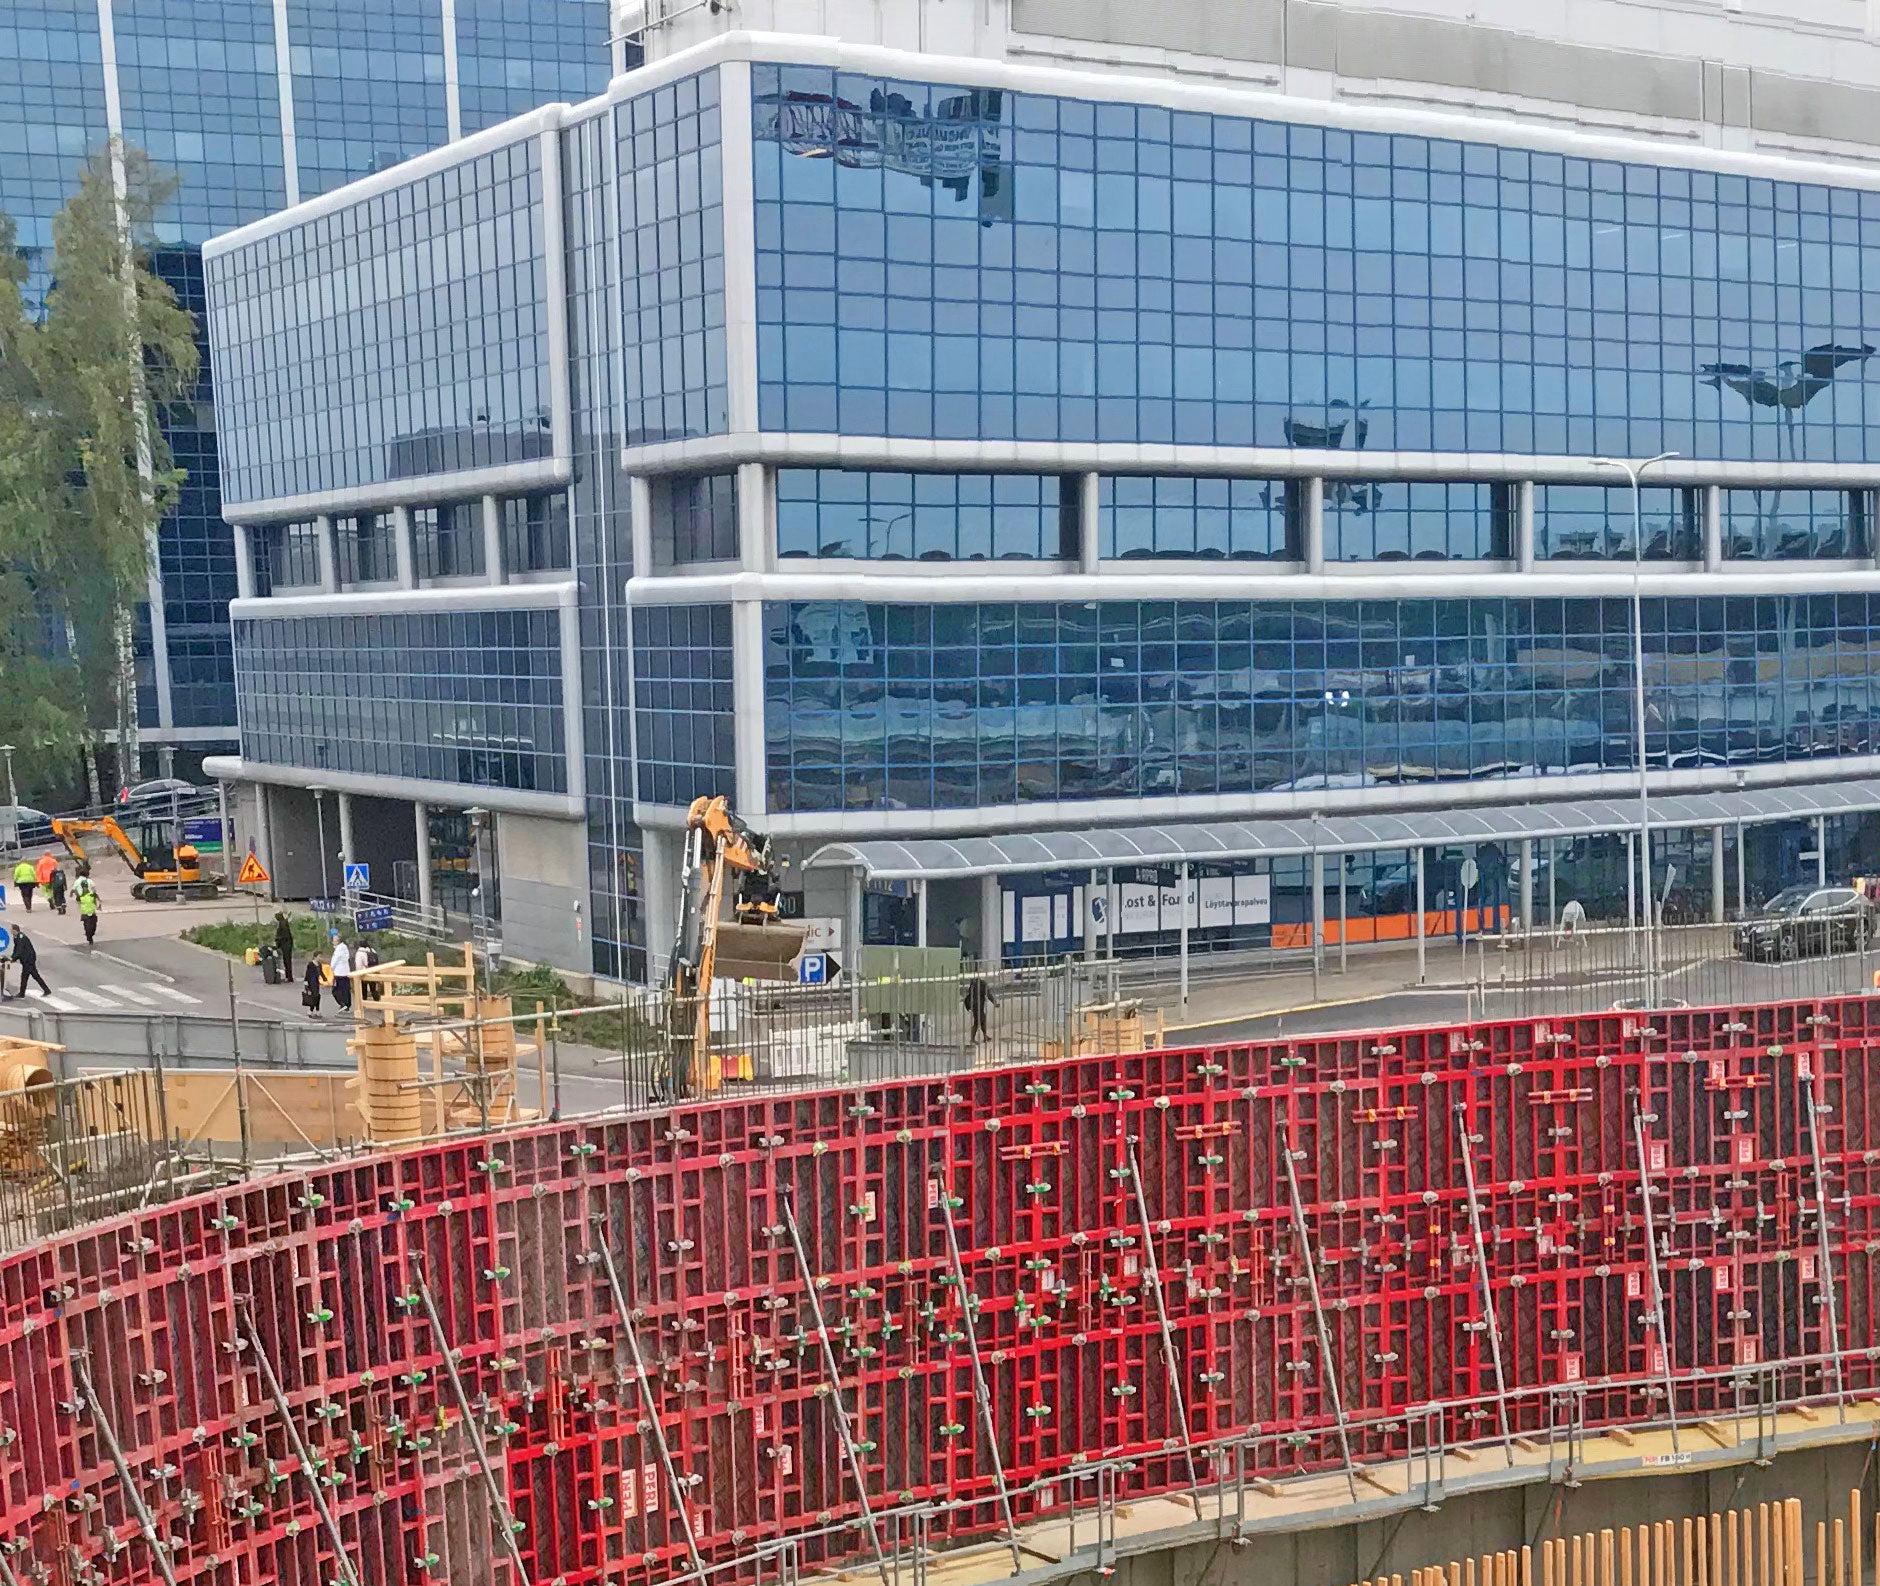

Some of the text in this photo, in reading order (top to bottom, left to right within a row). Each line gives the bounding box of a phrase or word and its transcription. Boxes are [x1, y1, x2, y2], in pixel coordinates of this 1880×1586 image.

[1147, 895, 1156, 907] &
[804, 958, 821, 981] P
[621, 1472, 634, 1515] PERI
[645, 1468, 657, 1511] PERI
